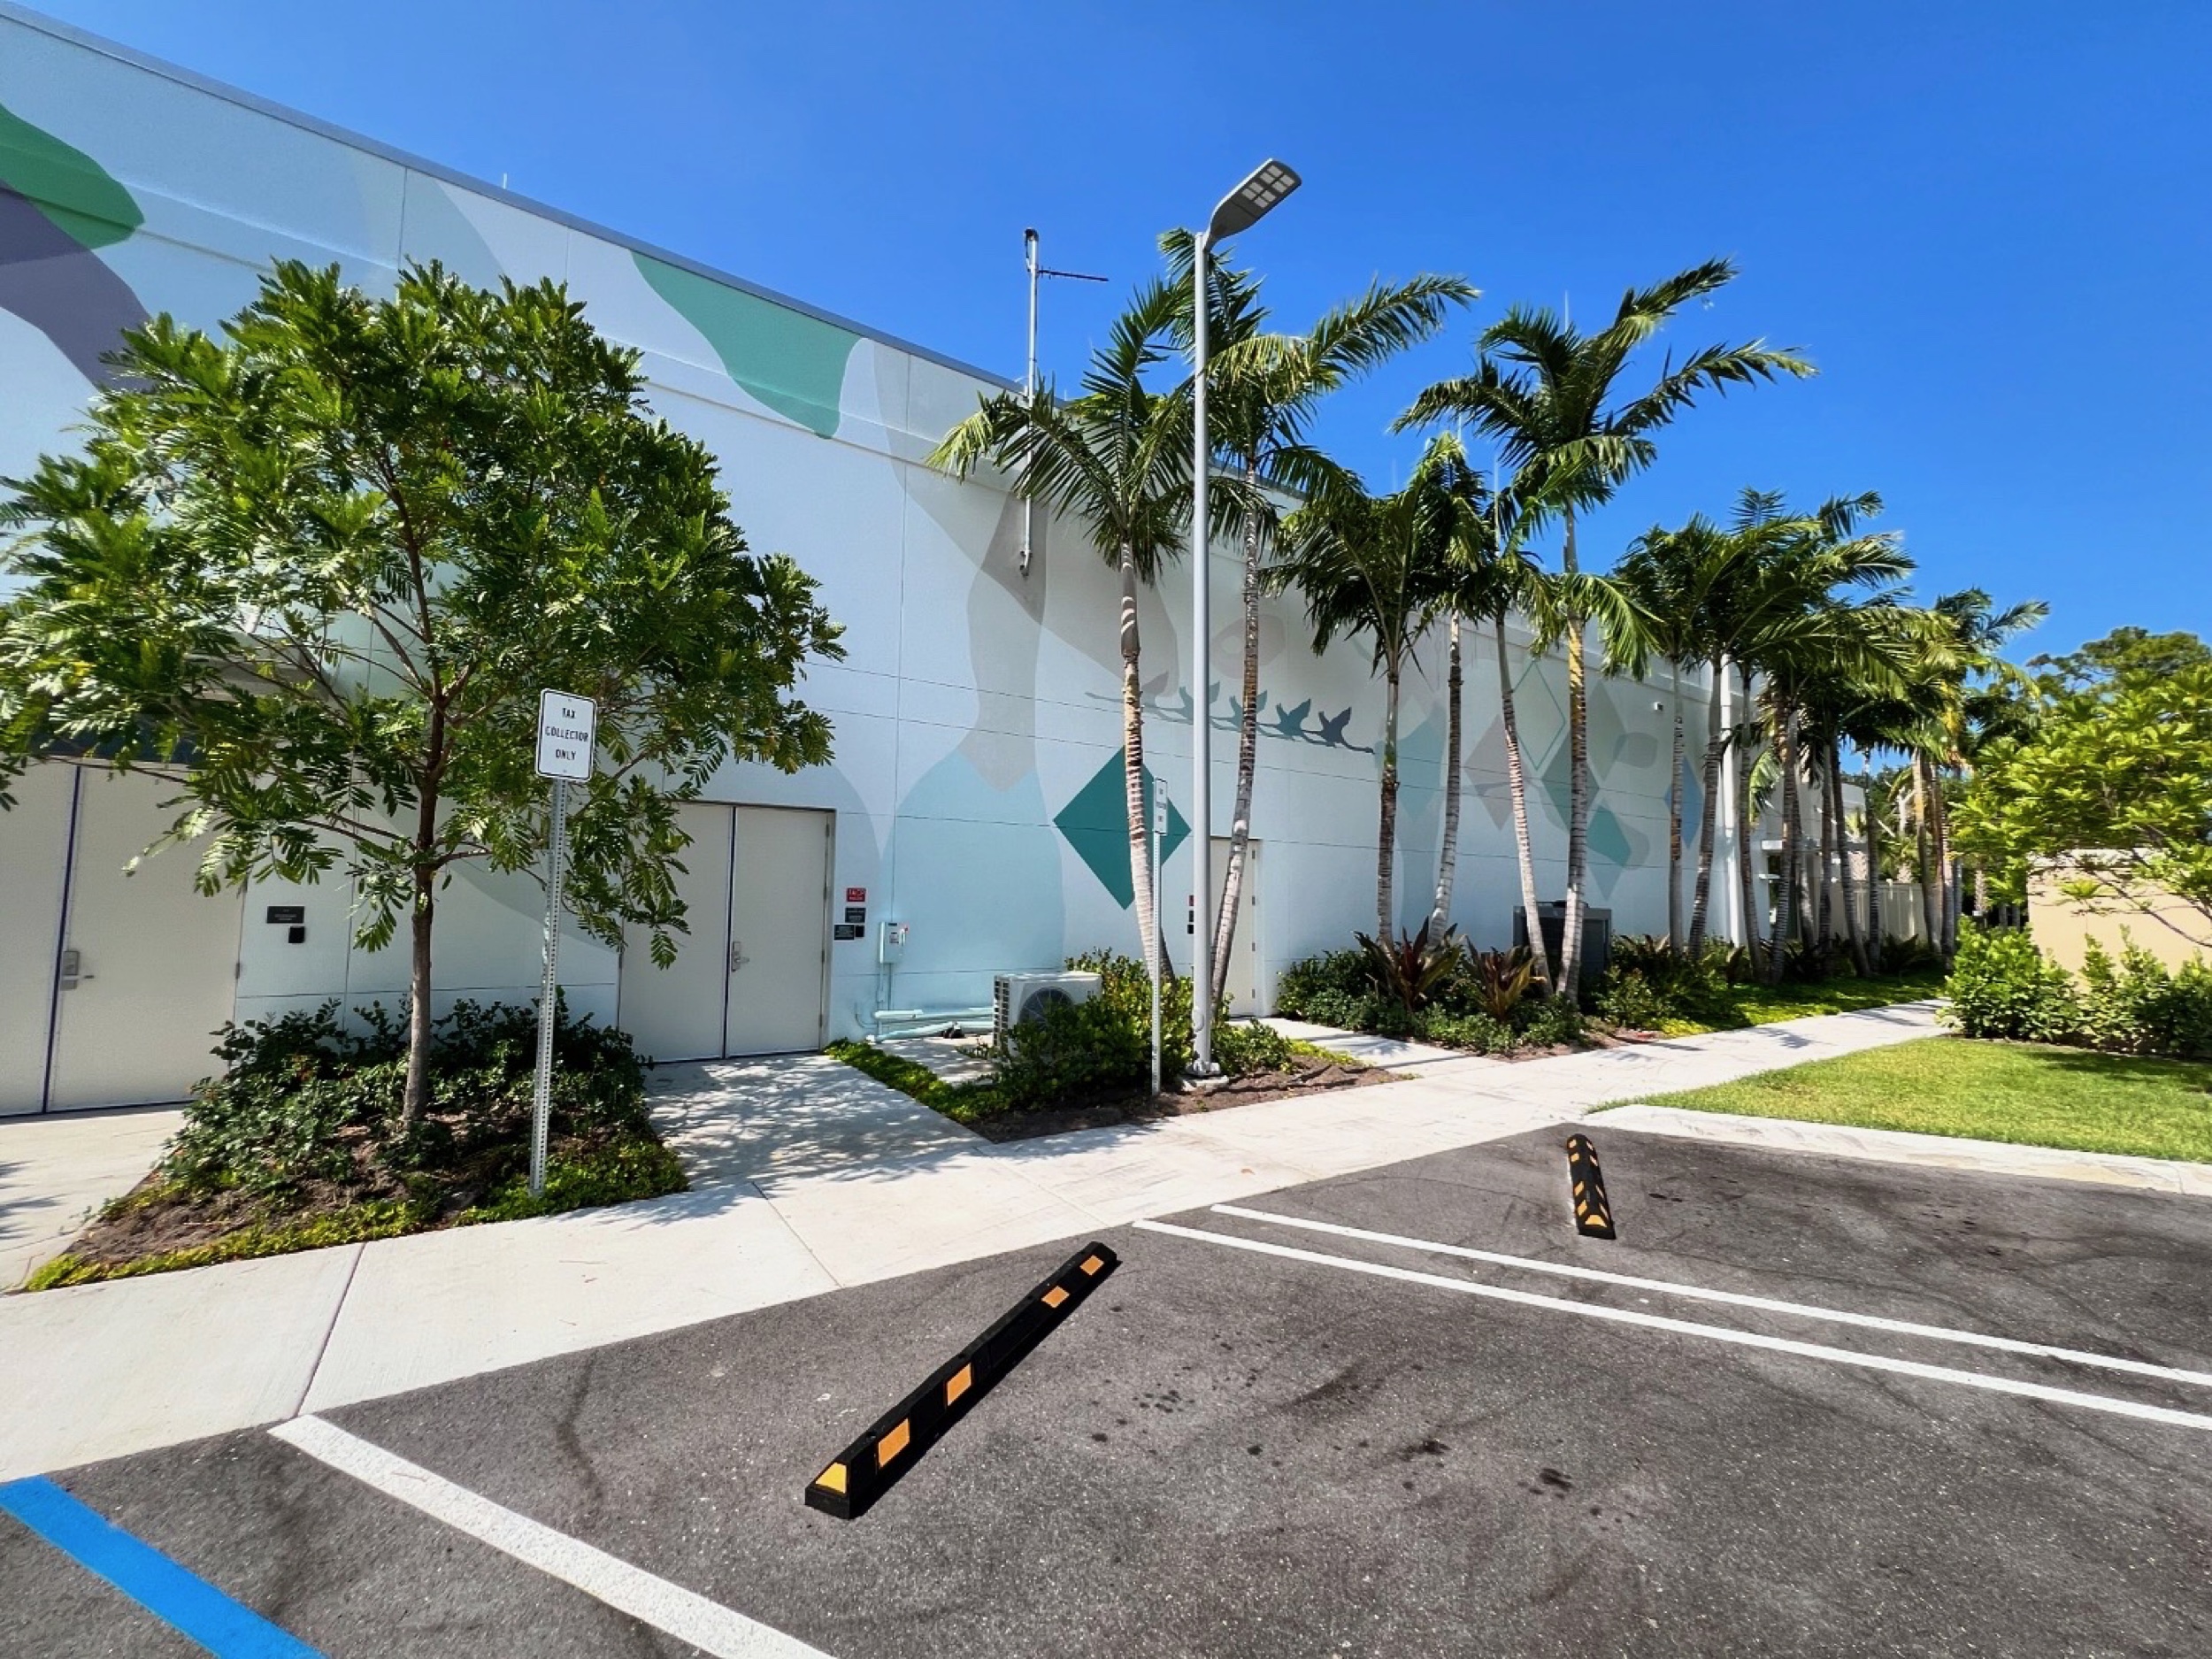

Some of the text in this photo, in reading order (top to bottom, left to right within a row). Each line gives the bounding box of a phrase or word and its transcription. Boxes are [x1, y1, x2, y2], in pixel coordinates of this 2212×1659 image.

[562, 708, 575, 718] TAX
[545, 726, 588, 742] COLLECTOR
[556, 749, 576, 760] ONLY
